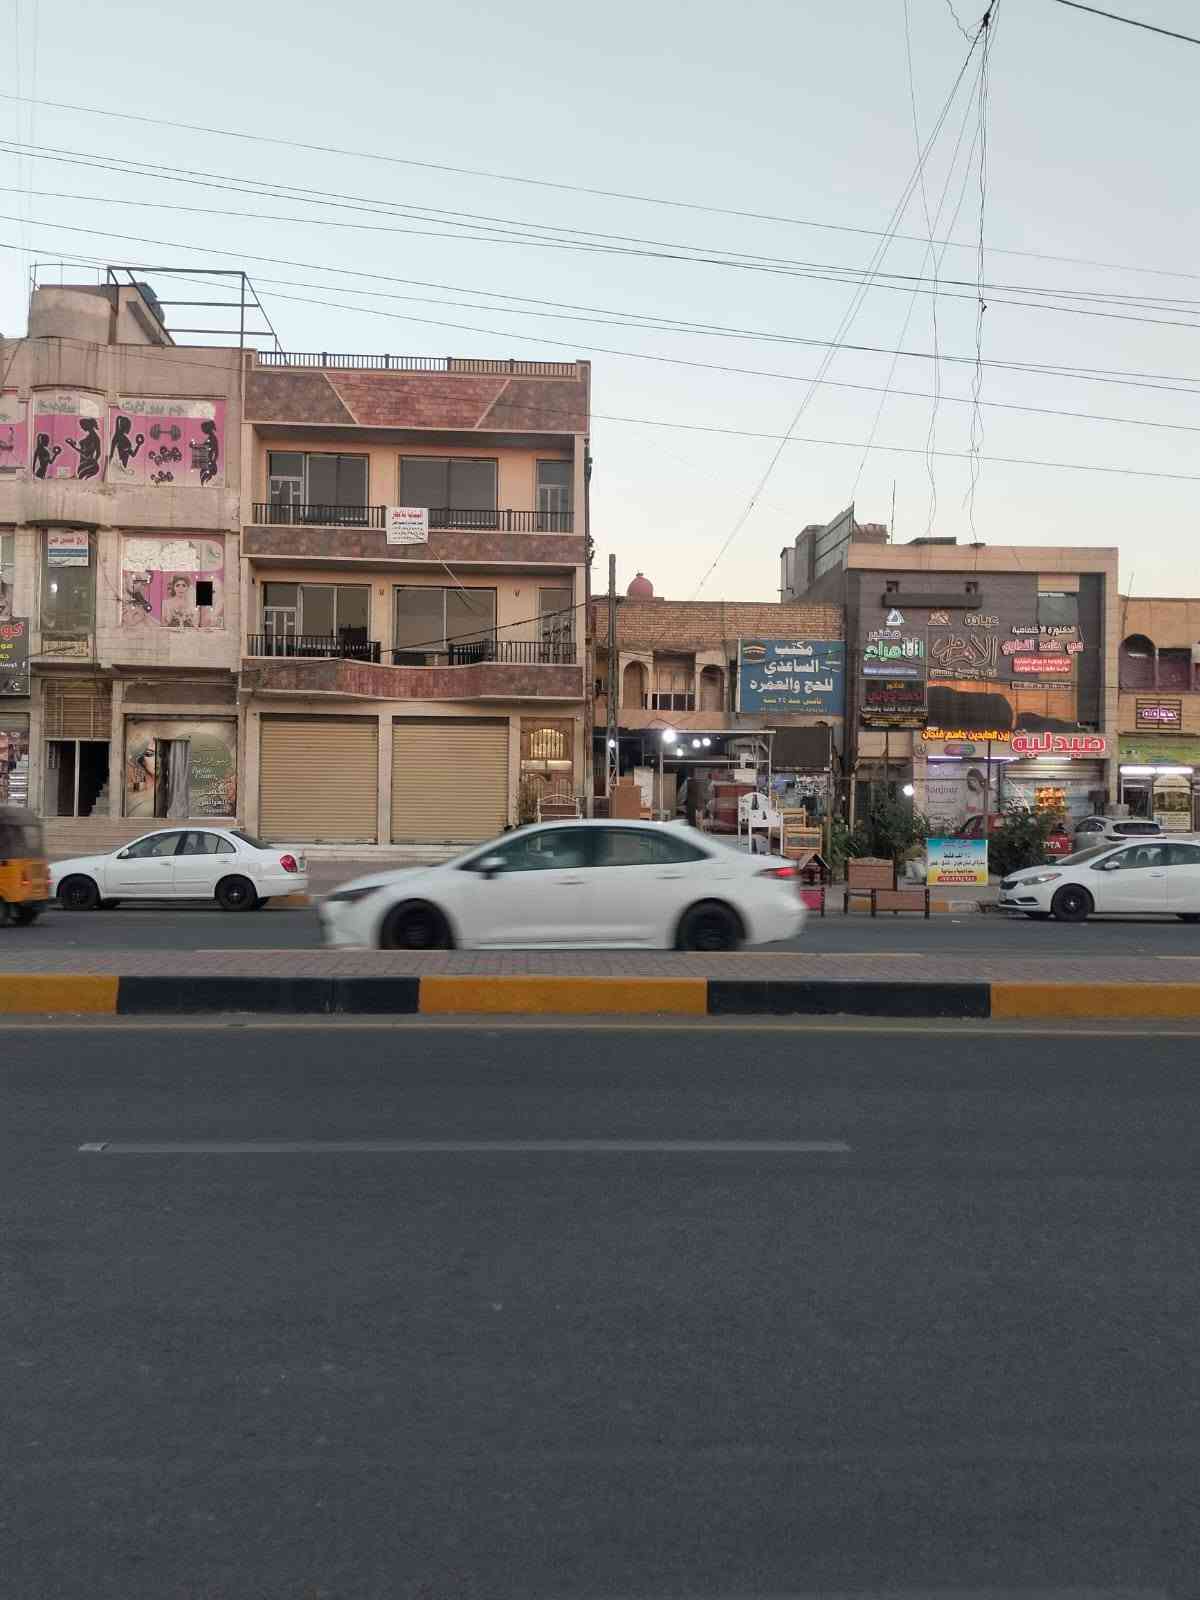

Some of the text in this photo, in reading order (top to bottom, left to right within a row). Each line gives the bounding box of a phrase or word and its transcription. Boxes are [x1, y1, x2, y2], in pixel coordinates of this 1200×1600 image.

[964, 612, 1000, 629] عيادة
[867, 628, 901, 642] مختبر
[774, 640, 813, 657] مكتب
[763, 658, 819, 677] الساعدي
[749, 677, 833, 694] للحج والعمره
[945, 730, 967, 741] جاسم
[968, 730, 997, 741] العابدين
[1011, 730, 1105, 758] صيدلية
